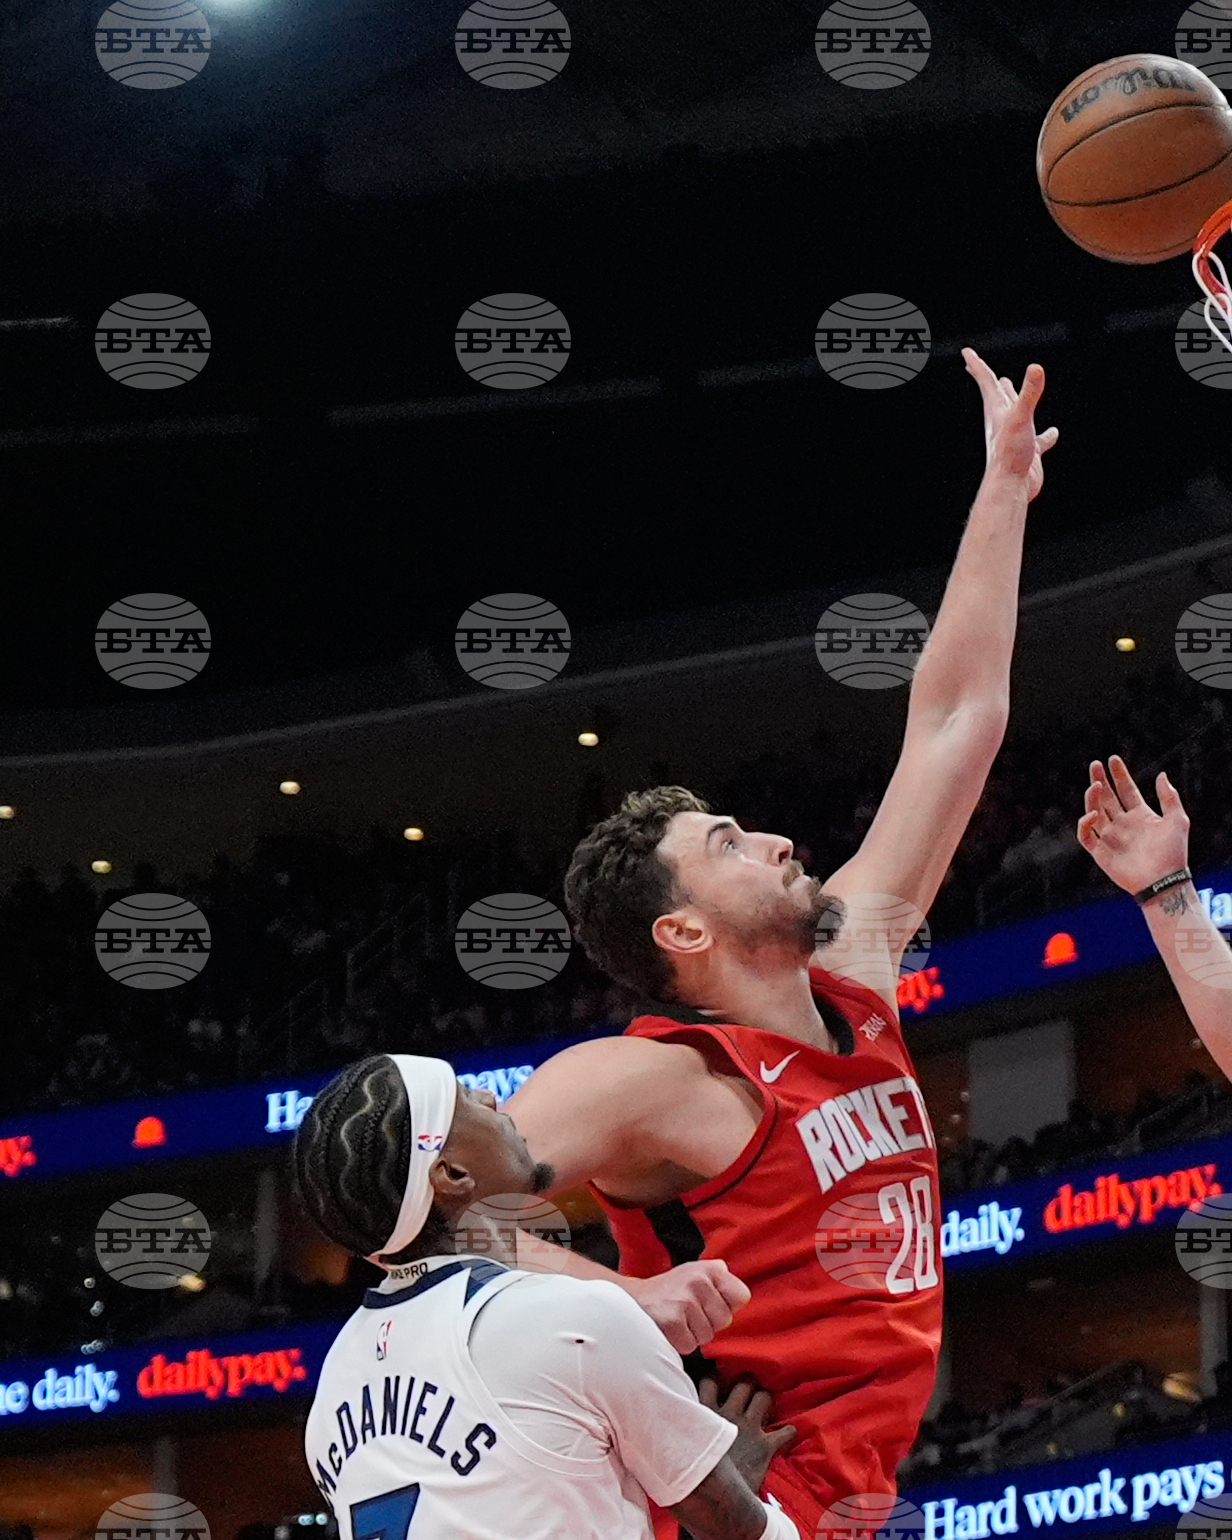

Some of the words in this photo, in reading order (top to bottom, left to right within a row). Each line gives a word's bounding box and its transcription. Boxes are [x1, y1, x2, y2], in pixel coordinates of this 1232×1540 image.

[940, 1200, 1026, 1258] daily.
[1043, 1163, 1223, 1232] dailypay.
[877, 1174, 939, 1295] 28
[33, 1362, 120, 1413] daily.
[137, 1347, 306, 1399] dailypay.
[1024, 1468, 1126, 1528] work
[1130, 1454, 1225, 1521] pays
